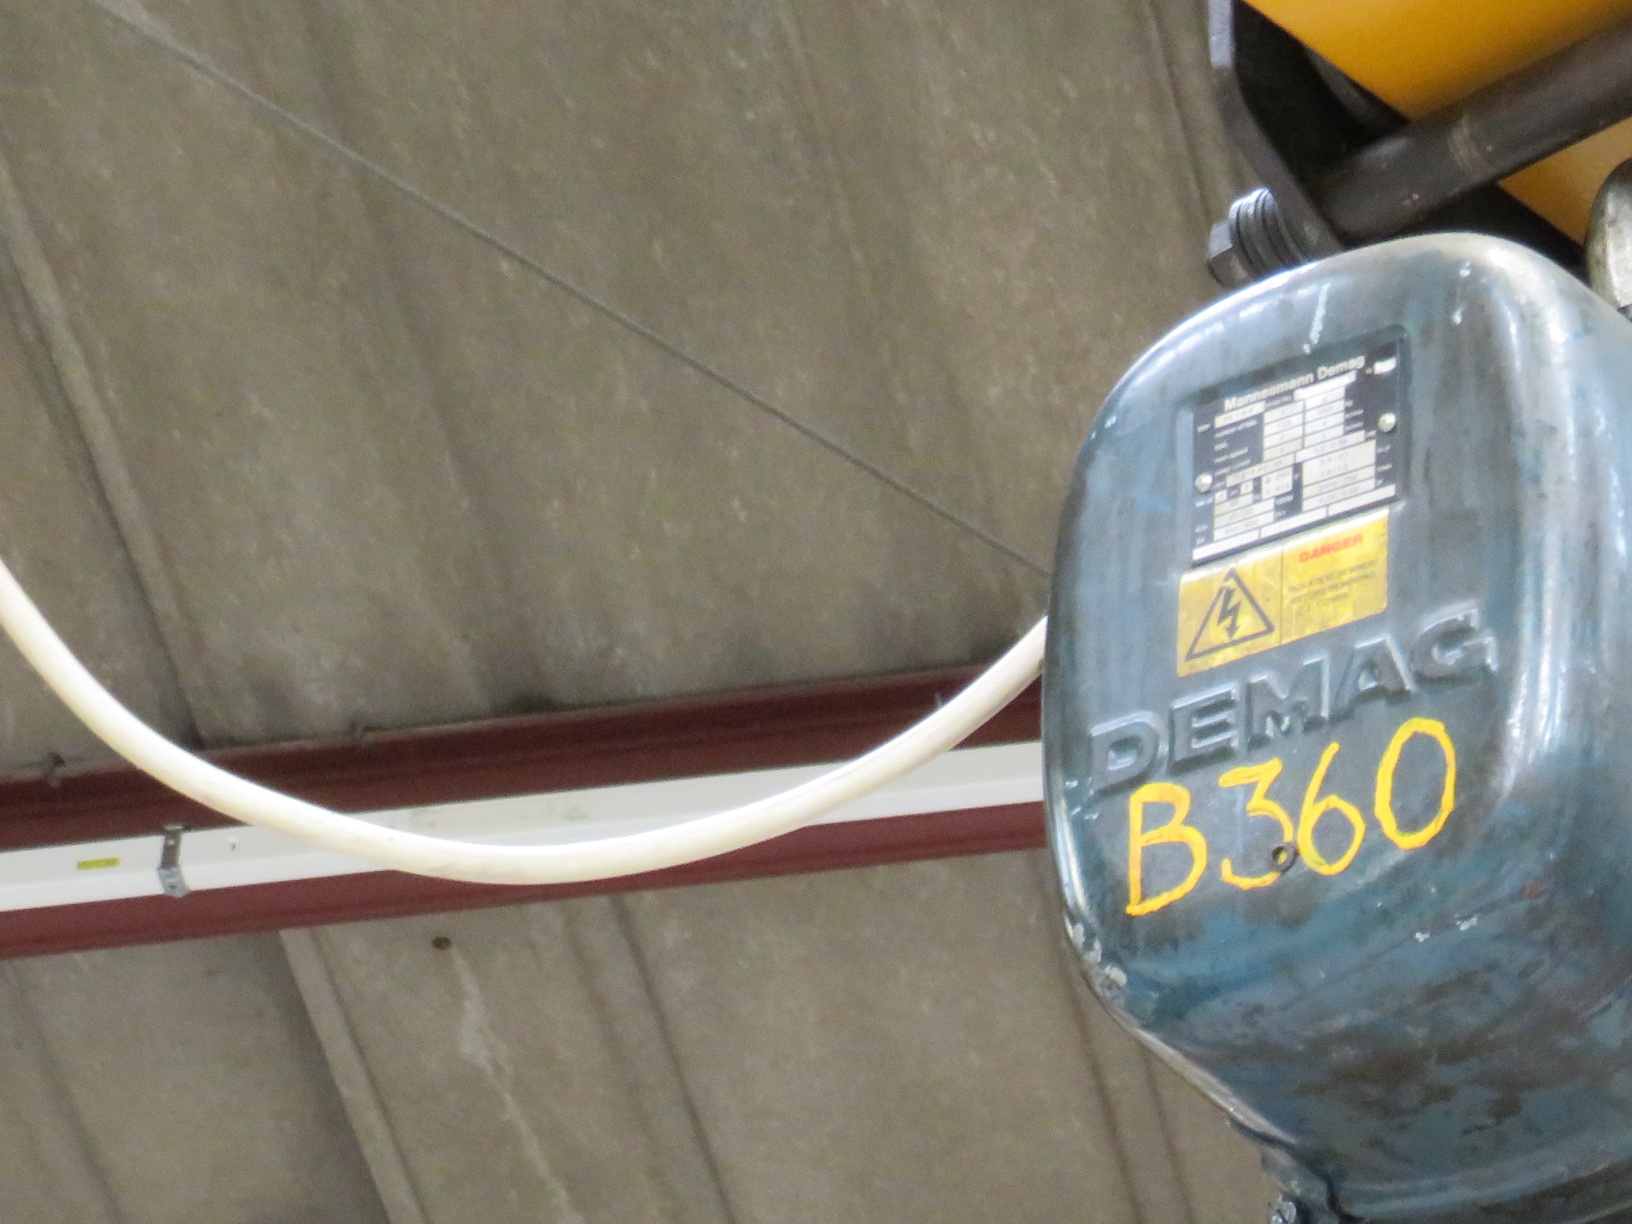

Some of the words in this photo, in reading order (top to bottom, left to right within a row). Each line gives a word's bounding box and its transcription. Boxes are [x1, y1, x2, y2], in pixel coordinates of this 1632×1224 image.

[1224, 372, 1315, 412] Mannesmann
[1317, 355, 1366, 380] Demag
[1299, 534, 1363, 563] DANGER
[1090, 601, 1498, 793] DEMAG
[1126, 717, 1457, 917] B360
